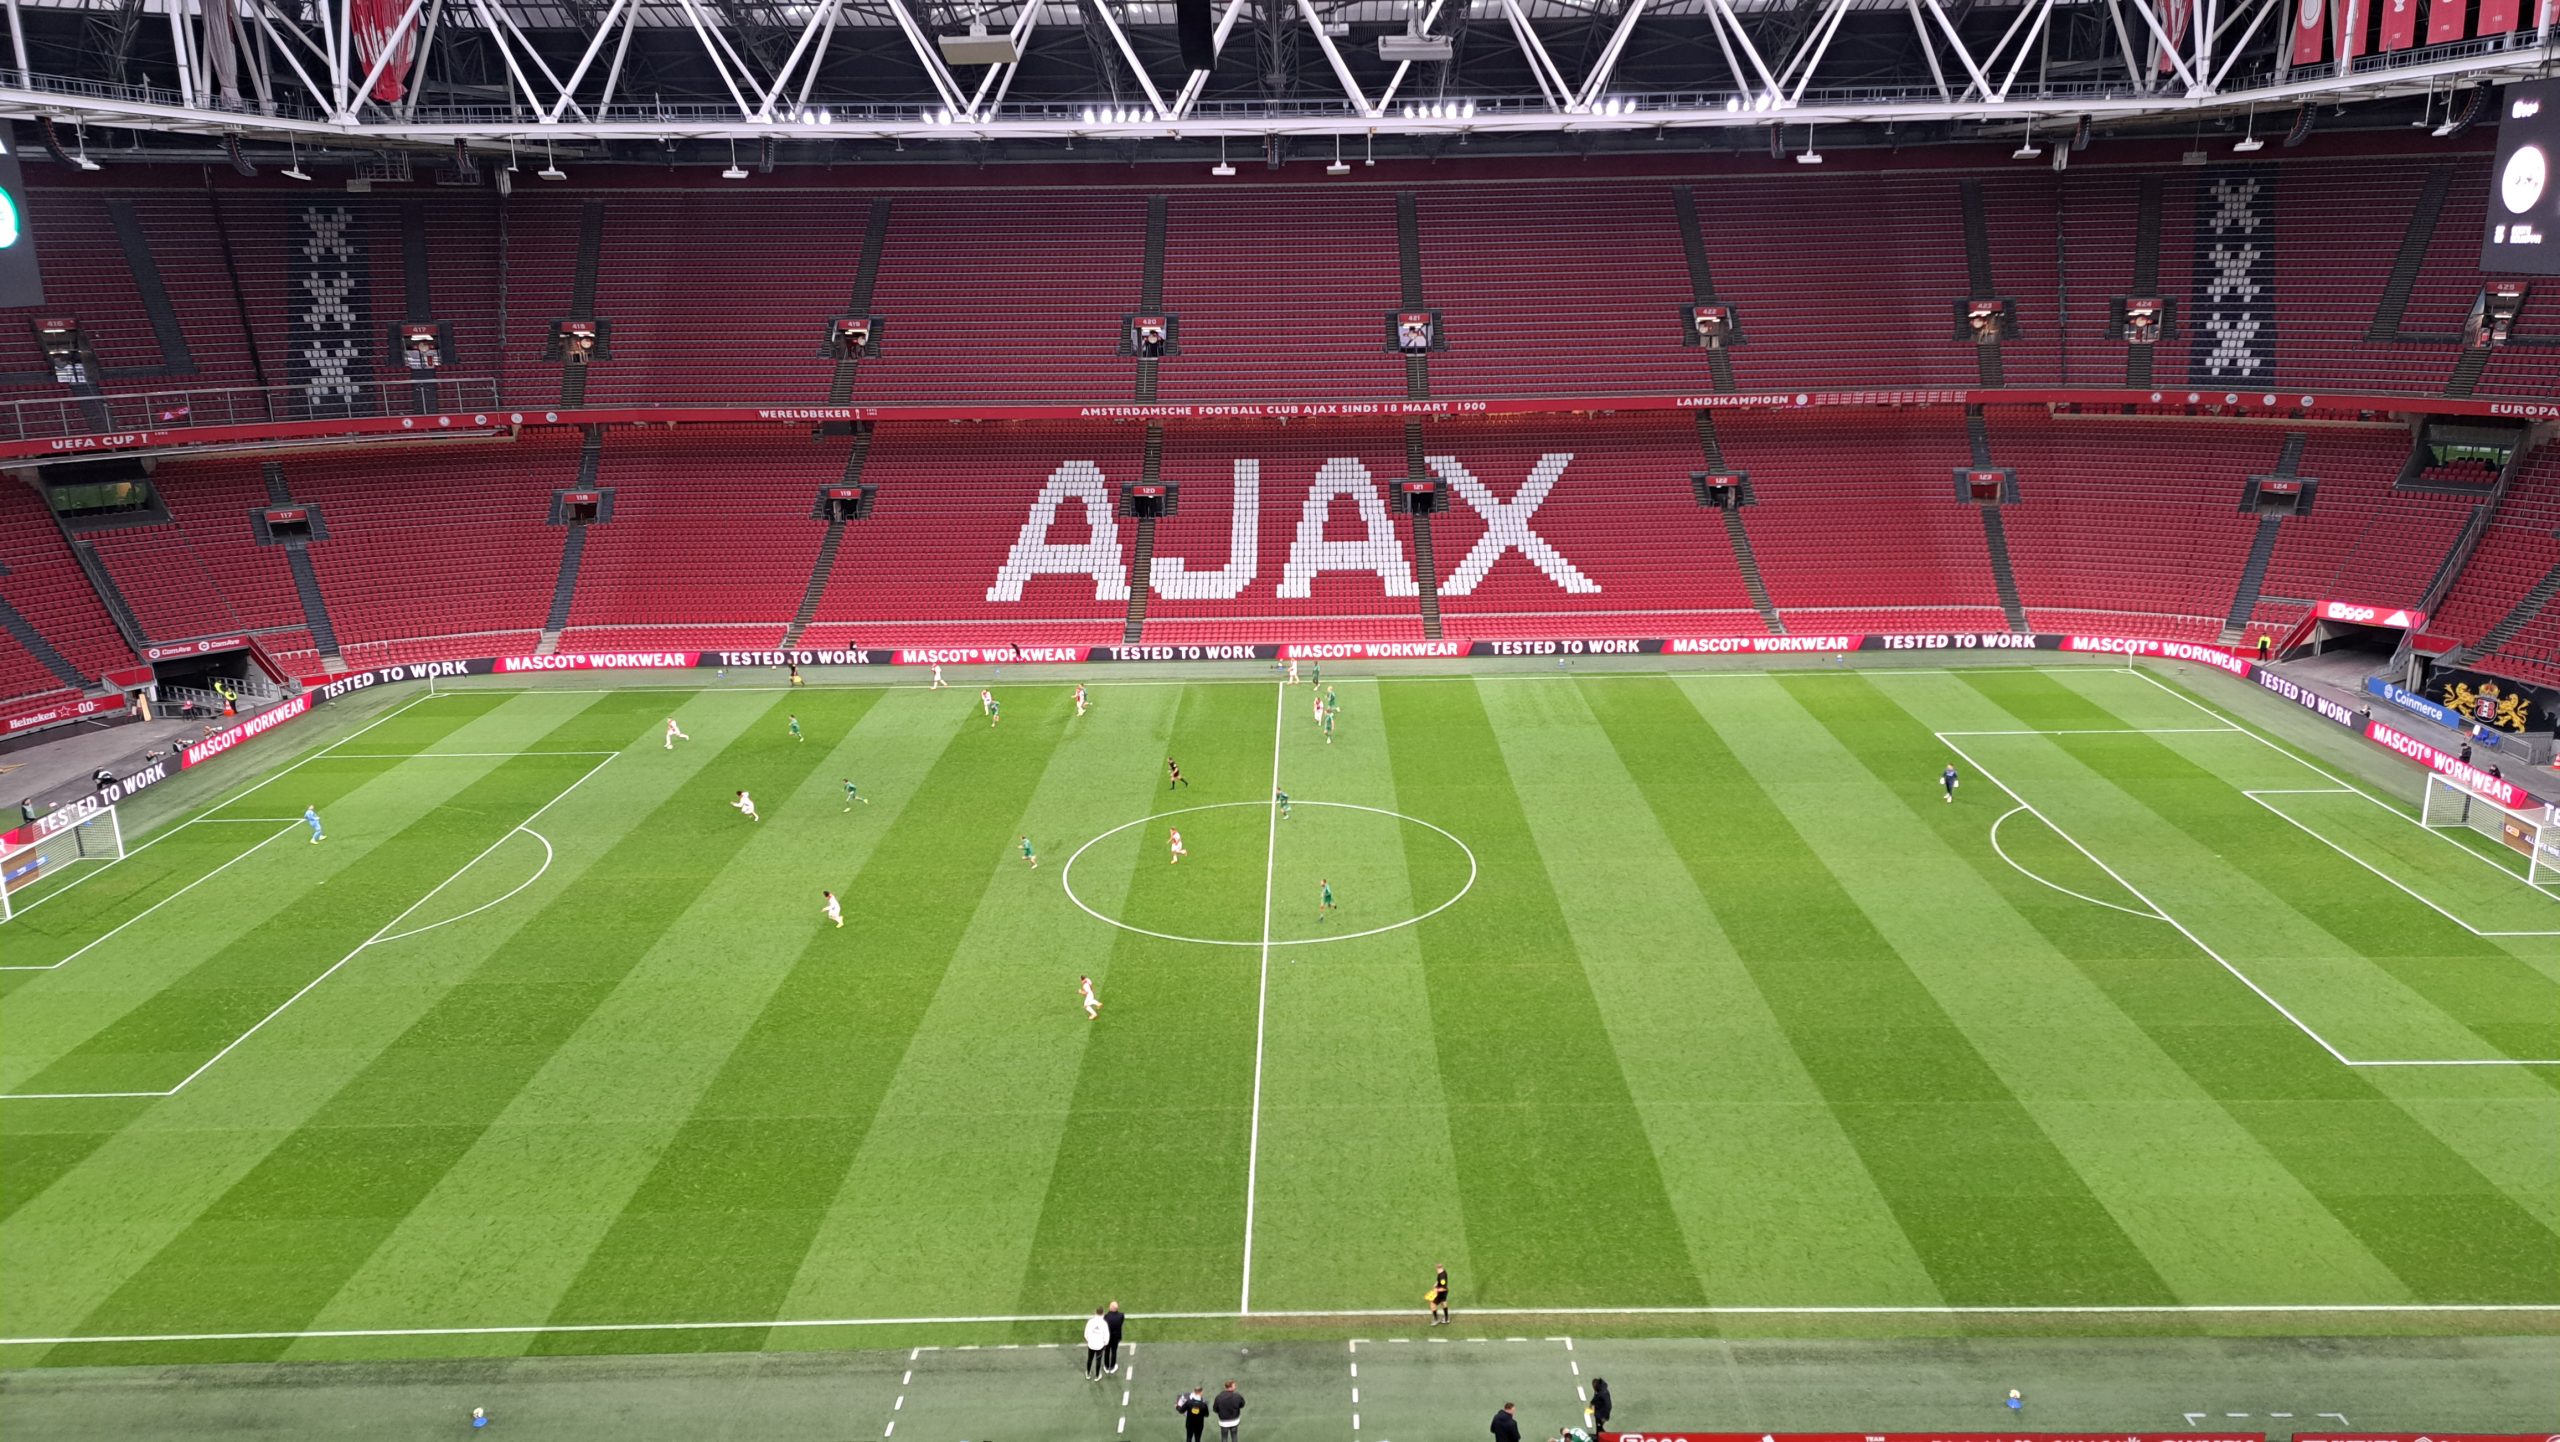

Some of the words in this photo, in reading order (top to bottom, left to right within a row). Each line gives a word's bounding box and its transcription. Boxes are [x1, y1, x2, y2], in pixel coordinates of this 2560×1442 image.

[1081, 407, 1192, 416] AMSTERDAMSCHE
[1199, 406, 1262, 415] FOOTBALL
[1266, 405, 1298, 414] CLUB
[1303, 404, 1336, 415] AJAX
[1342, 403, 1378, 413] SINDS
[1384, 403, 1397, 412] 18
[1403, 403, 1448, 412] MAART
[1457, 402, 1486, 411] 1900
[1676, 396, 1788, 406] LANDSKAMPIOEN
[759, 409, 851, 418] WERELDBEKER
[2490, 404, 2560, 417] EUROPA
[51, 438, 96, 450] UEFA
[102, 434, 136, 446] CUP
[986, 452, 1602, 601] AJAX
[1366, 642, 1458, 657] WORKWEAR
[1491, 641, 1556, 655] TESTED
[1561, 640, 1583, 654] TO
[1588, 639, 1640, 654] WORK
[1753, 636, 1849, 650] WORKWEAR
[1883, 634, 1951, 650] TESTED
[1954, 634, 1977, 648] TO
[1983, 633, 2036, 648] WORK
[590, 652, 686, 668] WORKWEAR
[719, 651, 785, 666] TESTED
[789, 650, 813, 665] TO
[818, 649, 870, 665] WORK
[982, 647, 1076, 662] WORKWEAR
[1109, 646, 1177, 661] TESTED
[1180, 646, 1200, 660] TO
[1204, 645, 1256, 660] WORK
[2162, 641, 2242, 675] WORKWEAR
[323, 672, 375, 700] TESTED
[382, 667, 404, 683] TO
[410, 660, 469, 679] WORK
[2259, 669, 2299, 701] TESTED
[2300, 688, 2316, 710] TO
[2317, 697, 2353, 727] WORK
[2394, 688, 2443, 721] Coinmerce
[9, 710, 57, 729] Heineken
[244, 698, 306, 737] WORKWEAR
[2434, 750, 2513, 804] WORKWEAR
[37, 795, 98, 836] TESTED
[100, 784, 121, 806] TO
[122, 762, 167, 795] WORK
